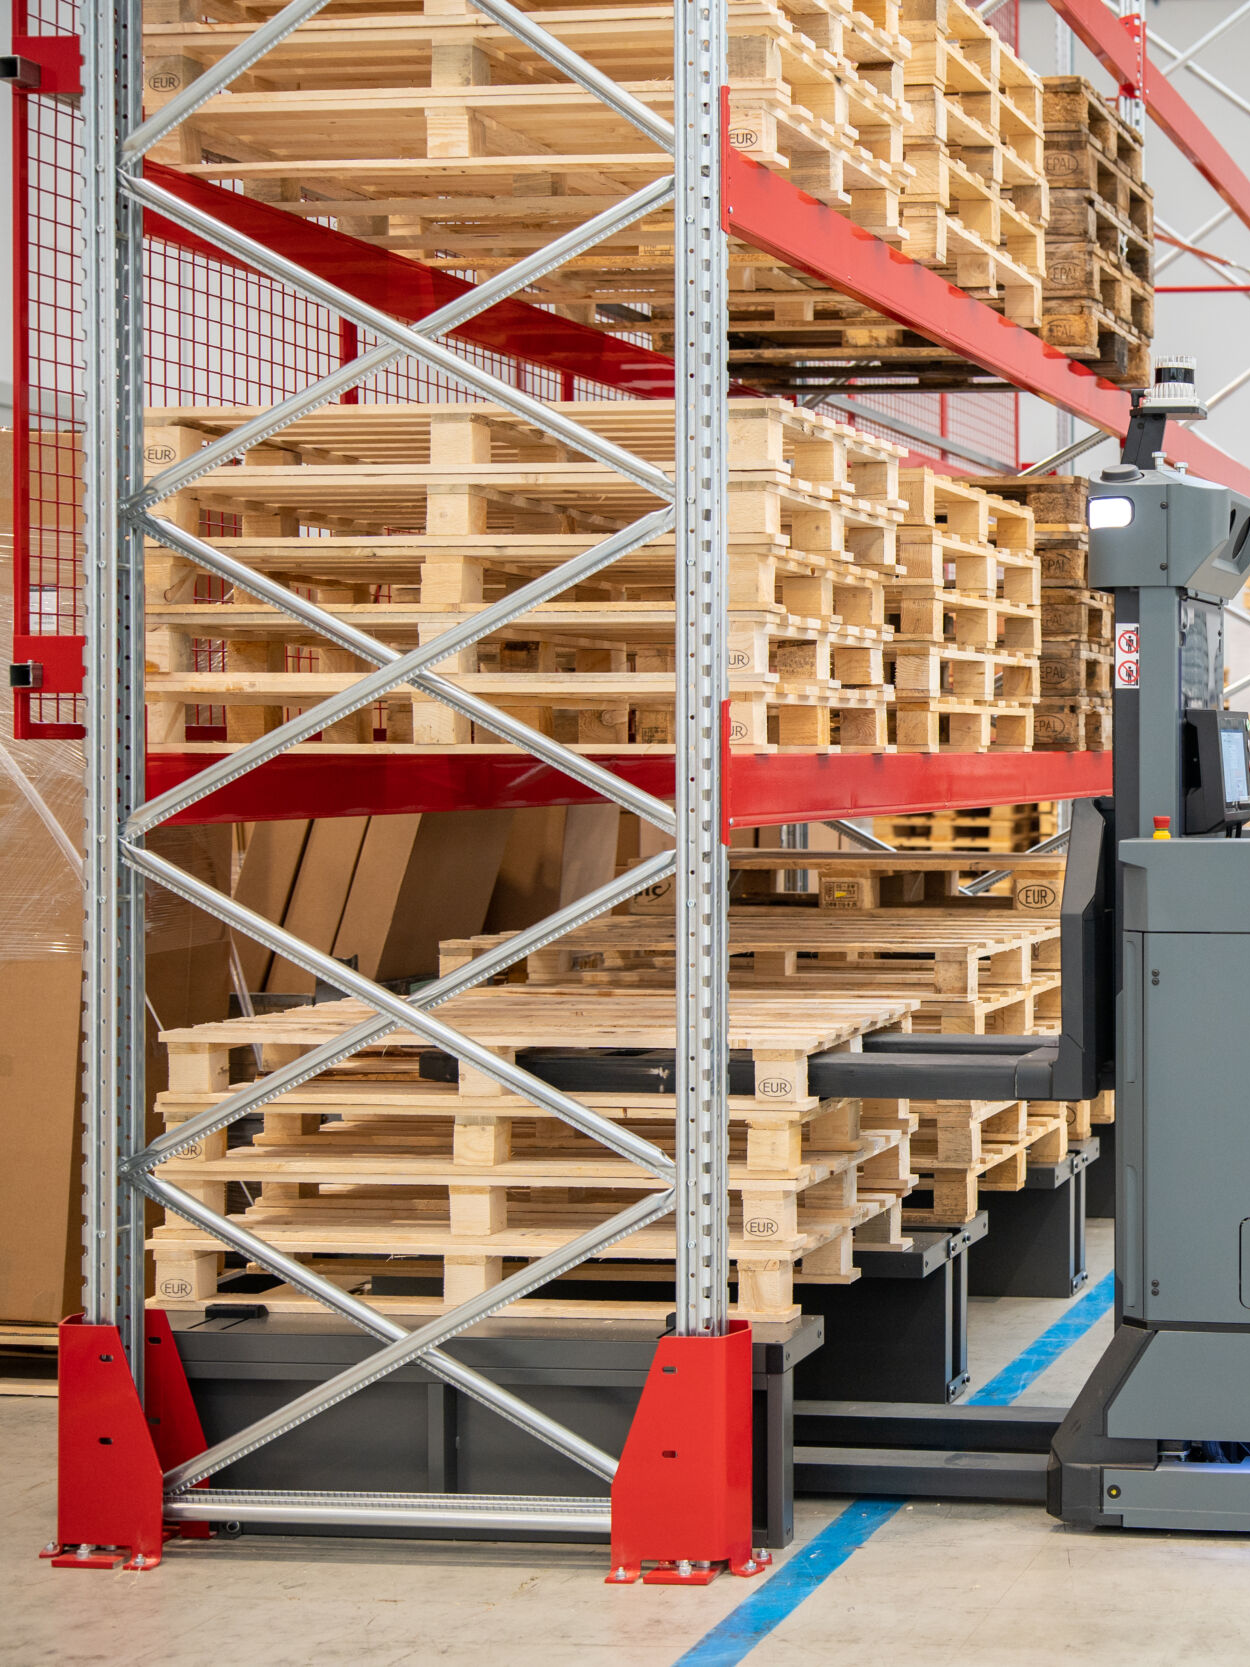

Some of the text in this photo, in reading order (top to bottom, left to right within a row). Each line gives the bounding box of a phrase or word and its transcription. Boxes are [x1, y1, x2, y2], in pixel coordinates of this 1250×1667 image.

[153, 76, 178, 89] EUR
[728, 132, 754, 145] EUR
[1046, 156, 1075, 171] EPAL
[147, 448, 172, 461] EUR
[728, 653, 746, 666] UR
[1025, 888, 1048, 905] EUR
[763, 1081, 789, 1094] EUR
[749, 1221, 776, 1233] EUR
[164, 1282, 190, 1295] EUR
